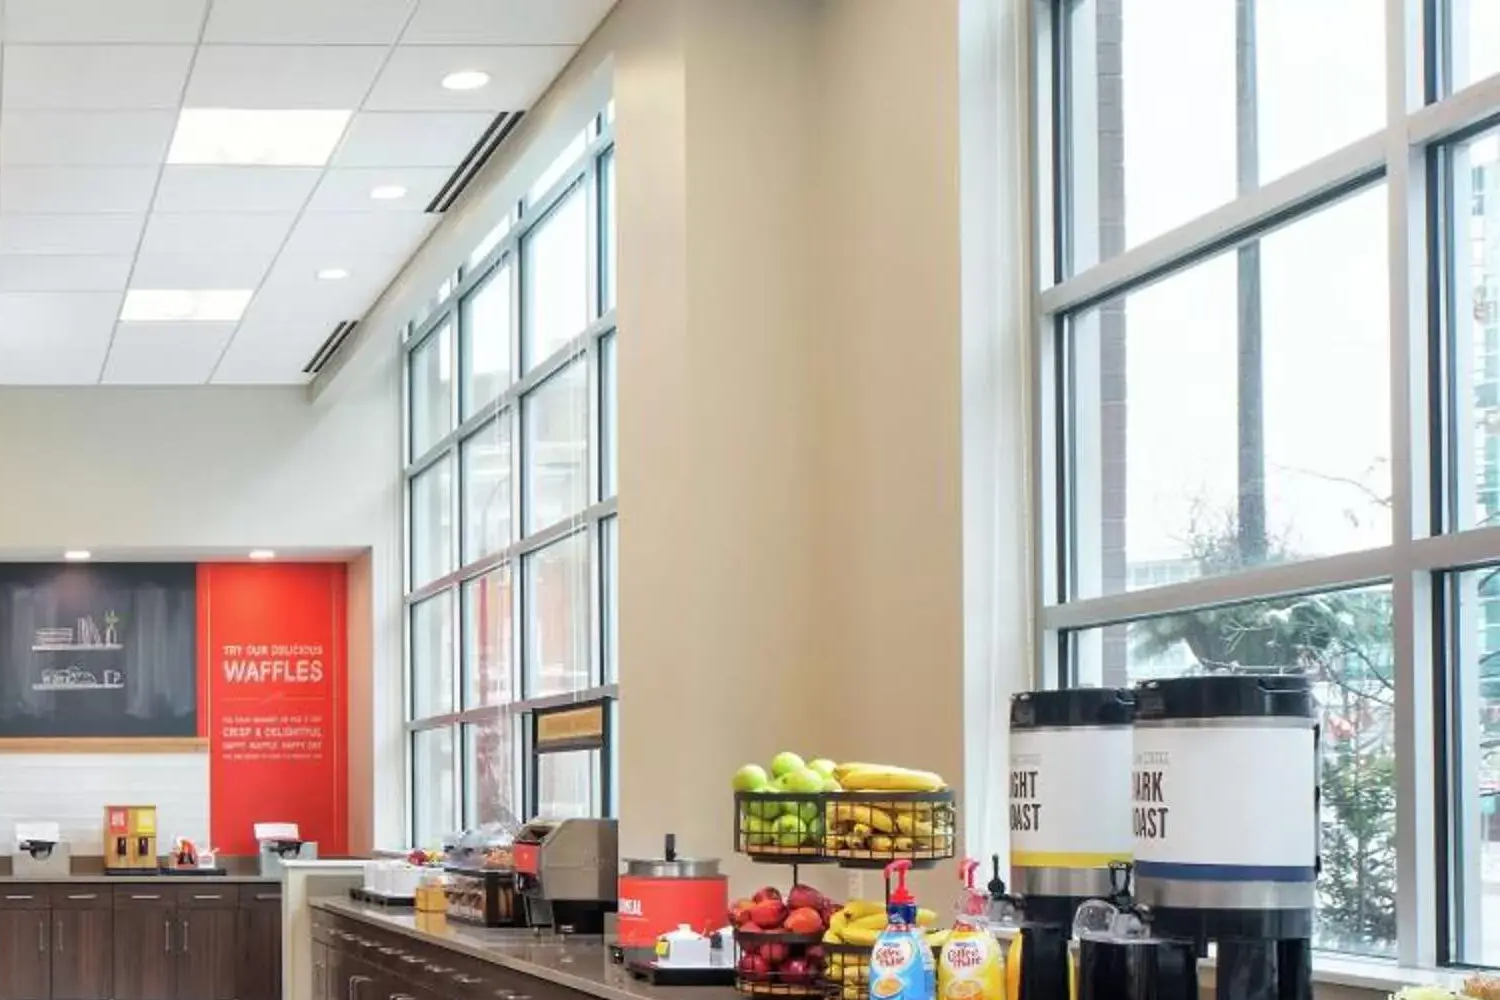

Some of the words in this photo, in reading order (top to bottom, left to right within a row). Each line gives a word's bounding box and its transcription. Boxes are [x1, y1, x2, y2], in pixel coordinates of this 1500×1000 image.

[246, 645, 268, 655] OUR
[223, 659, 323, 682] WAFFLES
[1132, 771, 1164, 802] ARK
[1009, 803, 1042, 831] OAST
[1132, 807, 1169, 838] OAST
